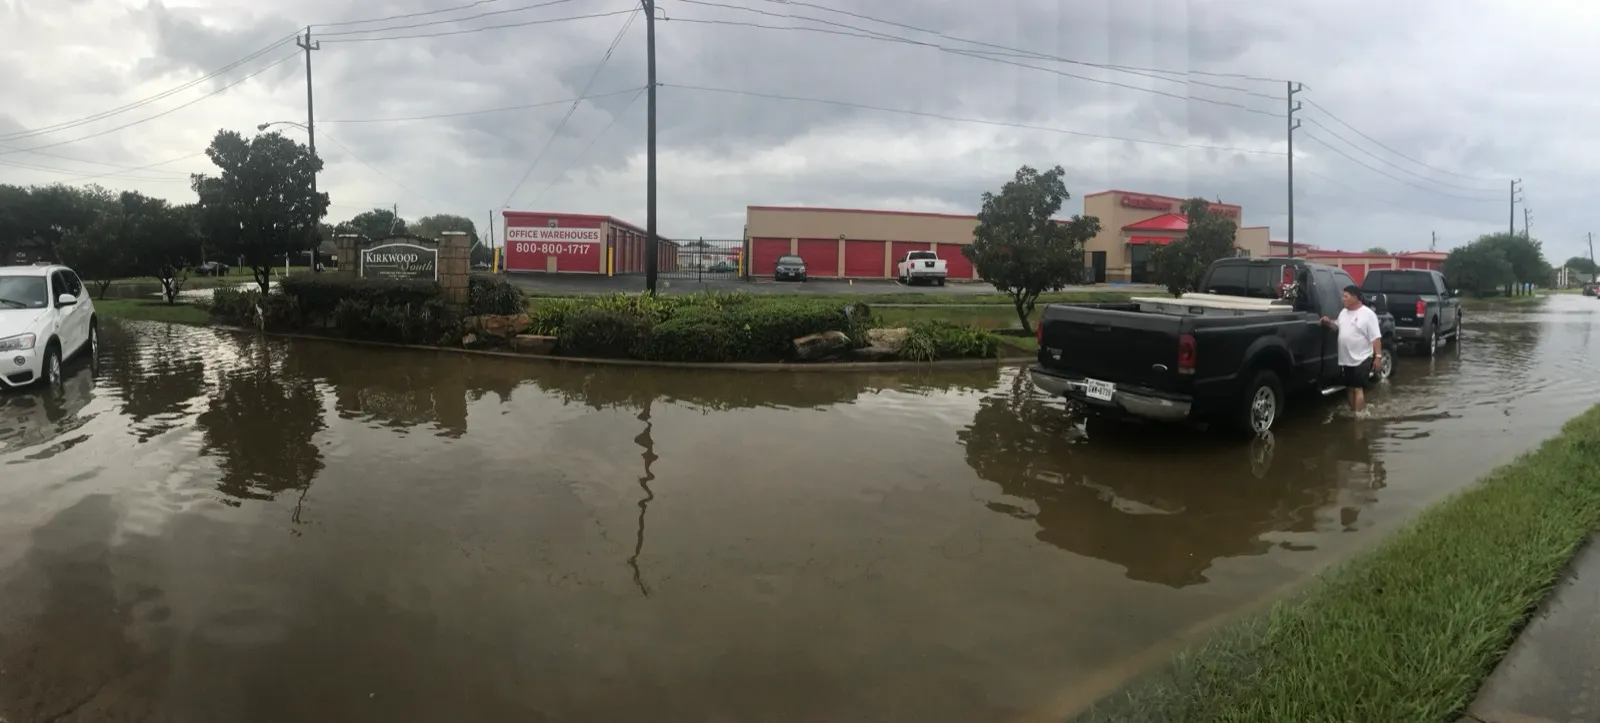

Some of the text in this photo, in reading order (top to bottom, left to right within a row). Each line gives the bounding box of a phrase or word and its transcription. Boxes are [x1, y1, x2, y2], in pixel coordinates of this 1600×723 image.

[509, 230, 598, 240] OFFICE WAREHOUSES
[516, 243, 590, 254] 800-800-1717
[401, 259, 433, 271] South
